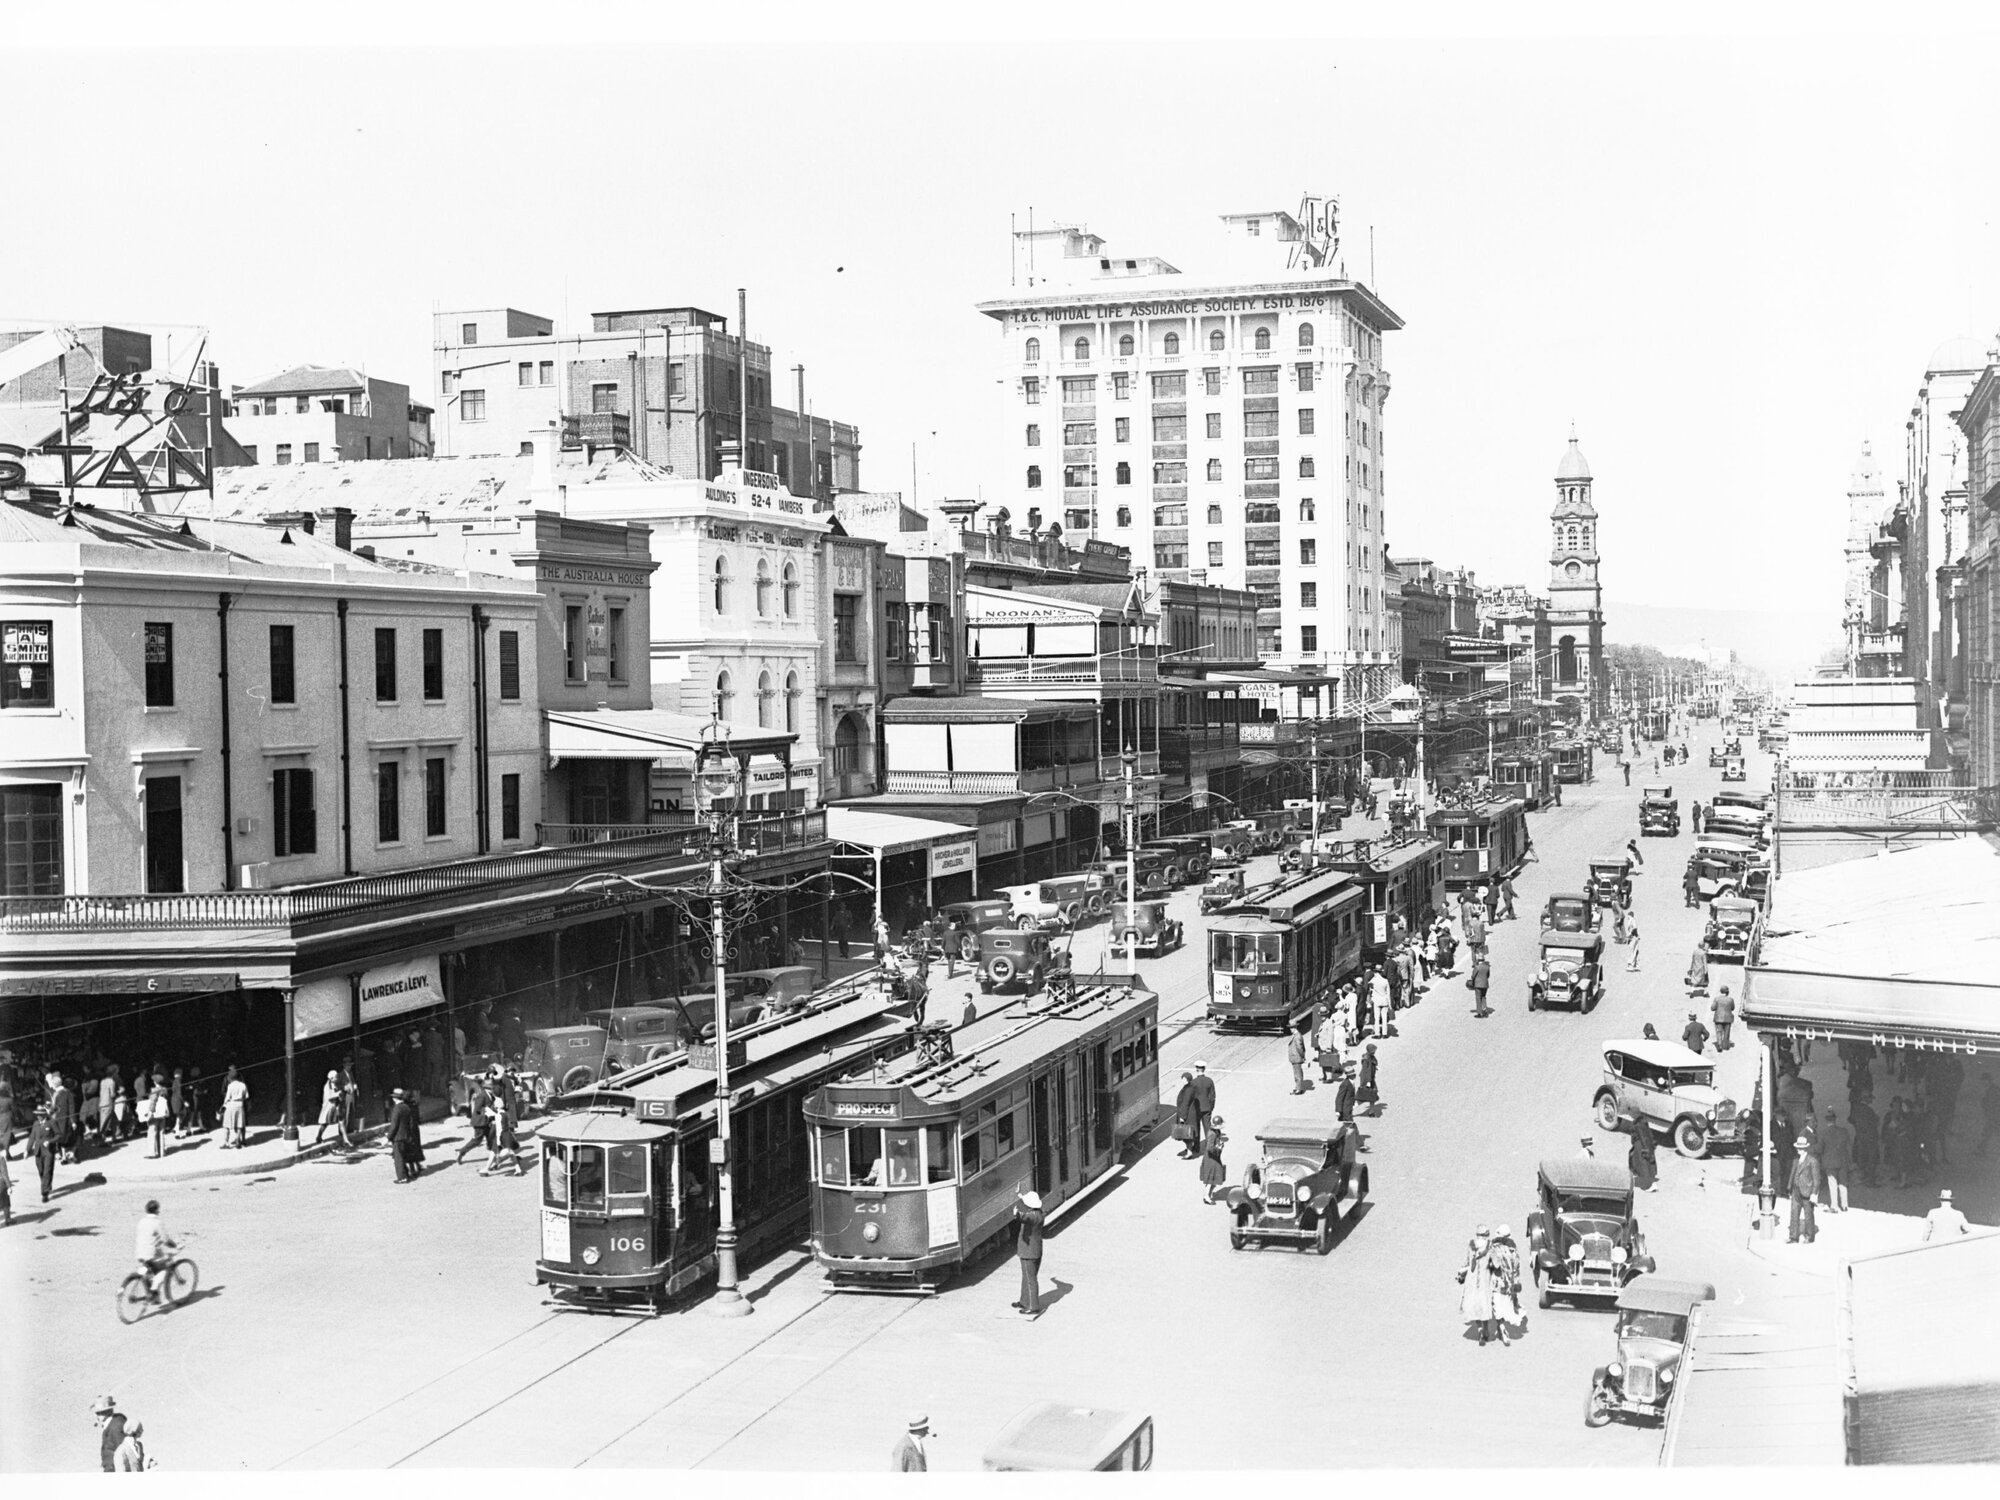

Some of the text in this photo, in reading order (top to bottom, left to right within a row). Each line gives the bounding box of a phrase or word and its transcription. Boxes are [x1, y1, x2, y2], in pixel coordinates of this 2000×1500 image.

[1046, 308, 1091, 321] MUTUAL
[1097, 306, 1122, 318] LIFE
[1130, 301, 1198, 317] ASSURANCE
[541, 566, 645, 585] THE AUSTRALIA HOUSE
[985, 609, 1067, 617] NOONAN'S
[4, 624, 48, 637] CHRIS
[20, 634, 31, 642] A
[6, 644, 48, 653] SMITH
[3, 653, 49, 662] ARCHITECT
[753, 771, 785, 782] TAILORS
[1277, 909, 1287, 918] 7
[0, 976, 233, 994] LAWRENCE & LEVY
[362, 980, 404, 1002] LAWRENCE
[1257, 985, 1274, 995] 151
[1786, 1025, 1977, 1055] ROY MORRIS
[642, 1102, 665, 1117] 16
[837, 1103, 898, 1115] PROSPECT
[610, 1237, 646, 1252] 106
